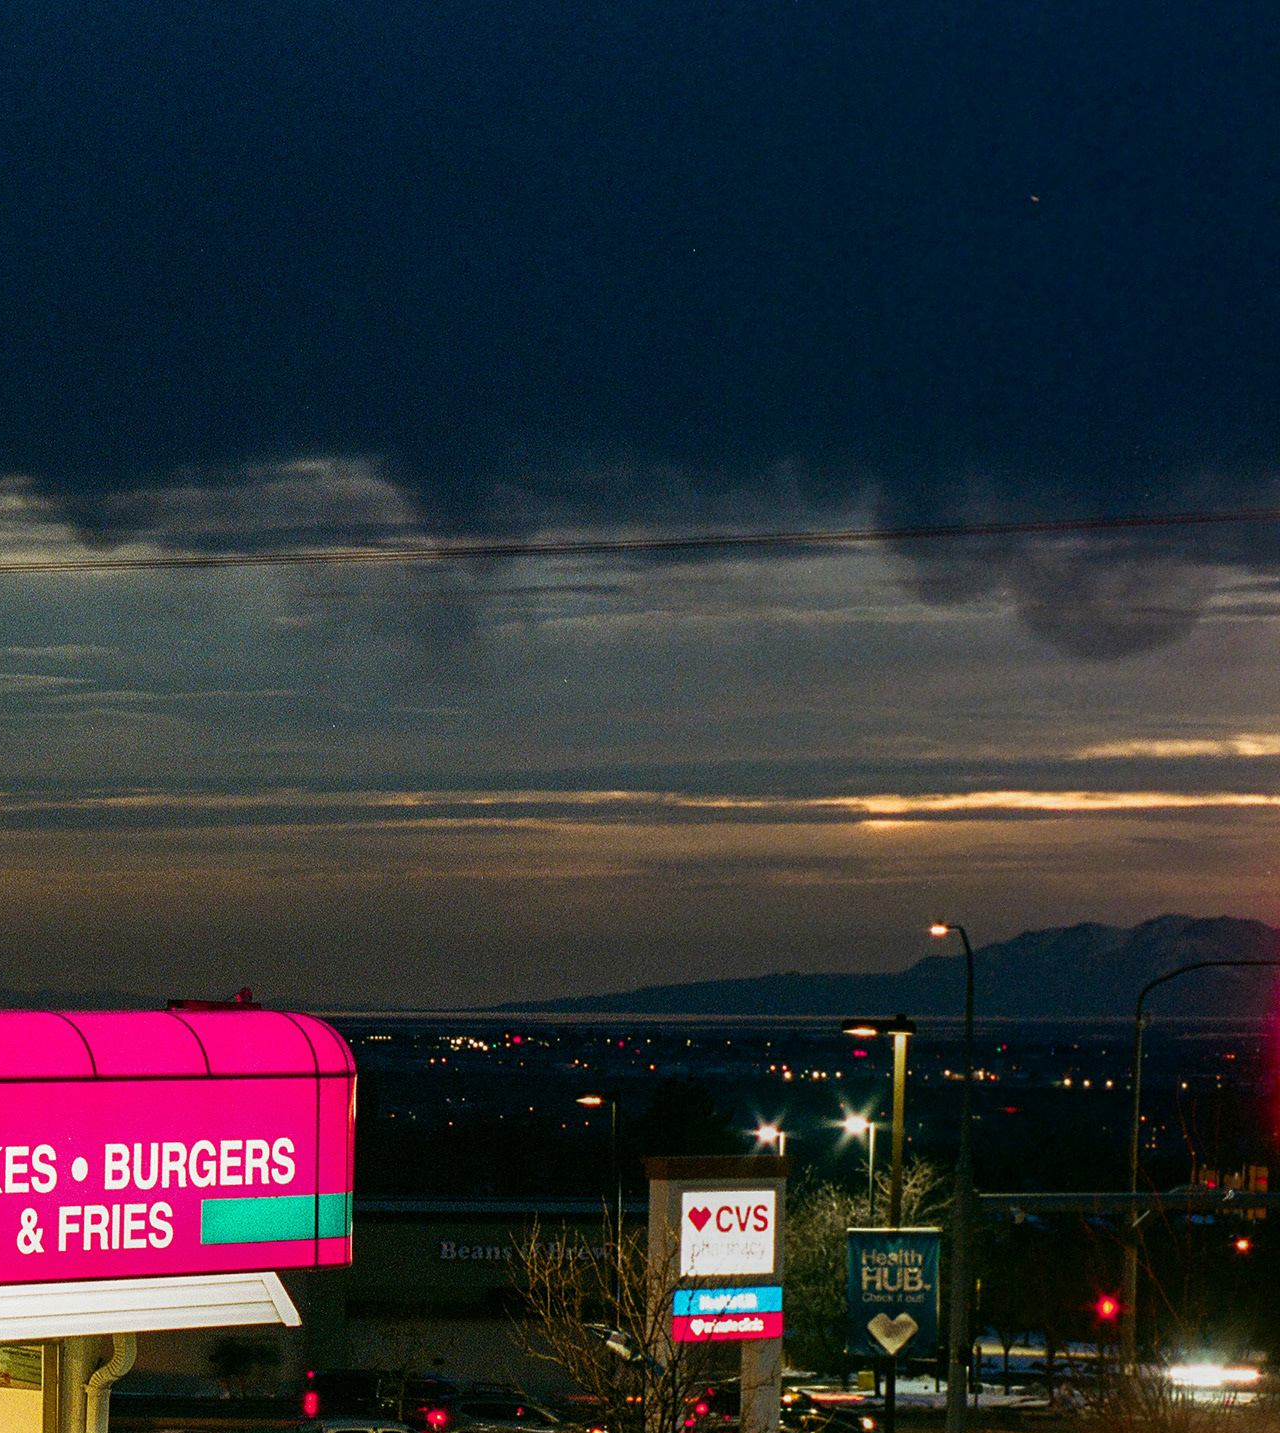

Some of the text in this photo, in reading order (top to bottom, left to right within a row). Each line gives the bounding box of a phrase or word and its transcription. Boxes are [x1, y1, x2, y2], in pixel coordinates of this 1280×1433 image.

[104, 1137, 296, 1190] BURGERS
[16, 1201, 174, 1255] & FRIES
[715, 1204, 769, 1233] CVS
[440, 1240, 513, 1260] Beans
[861, 1248, 923, 1266] Health
